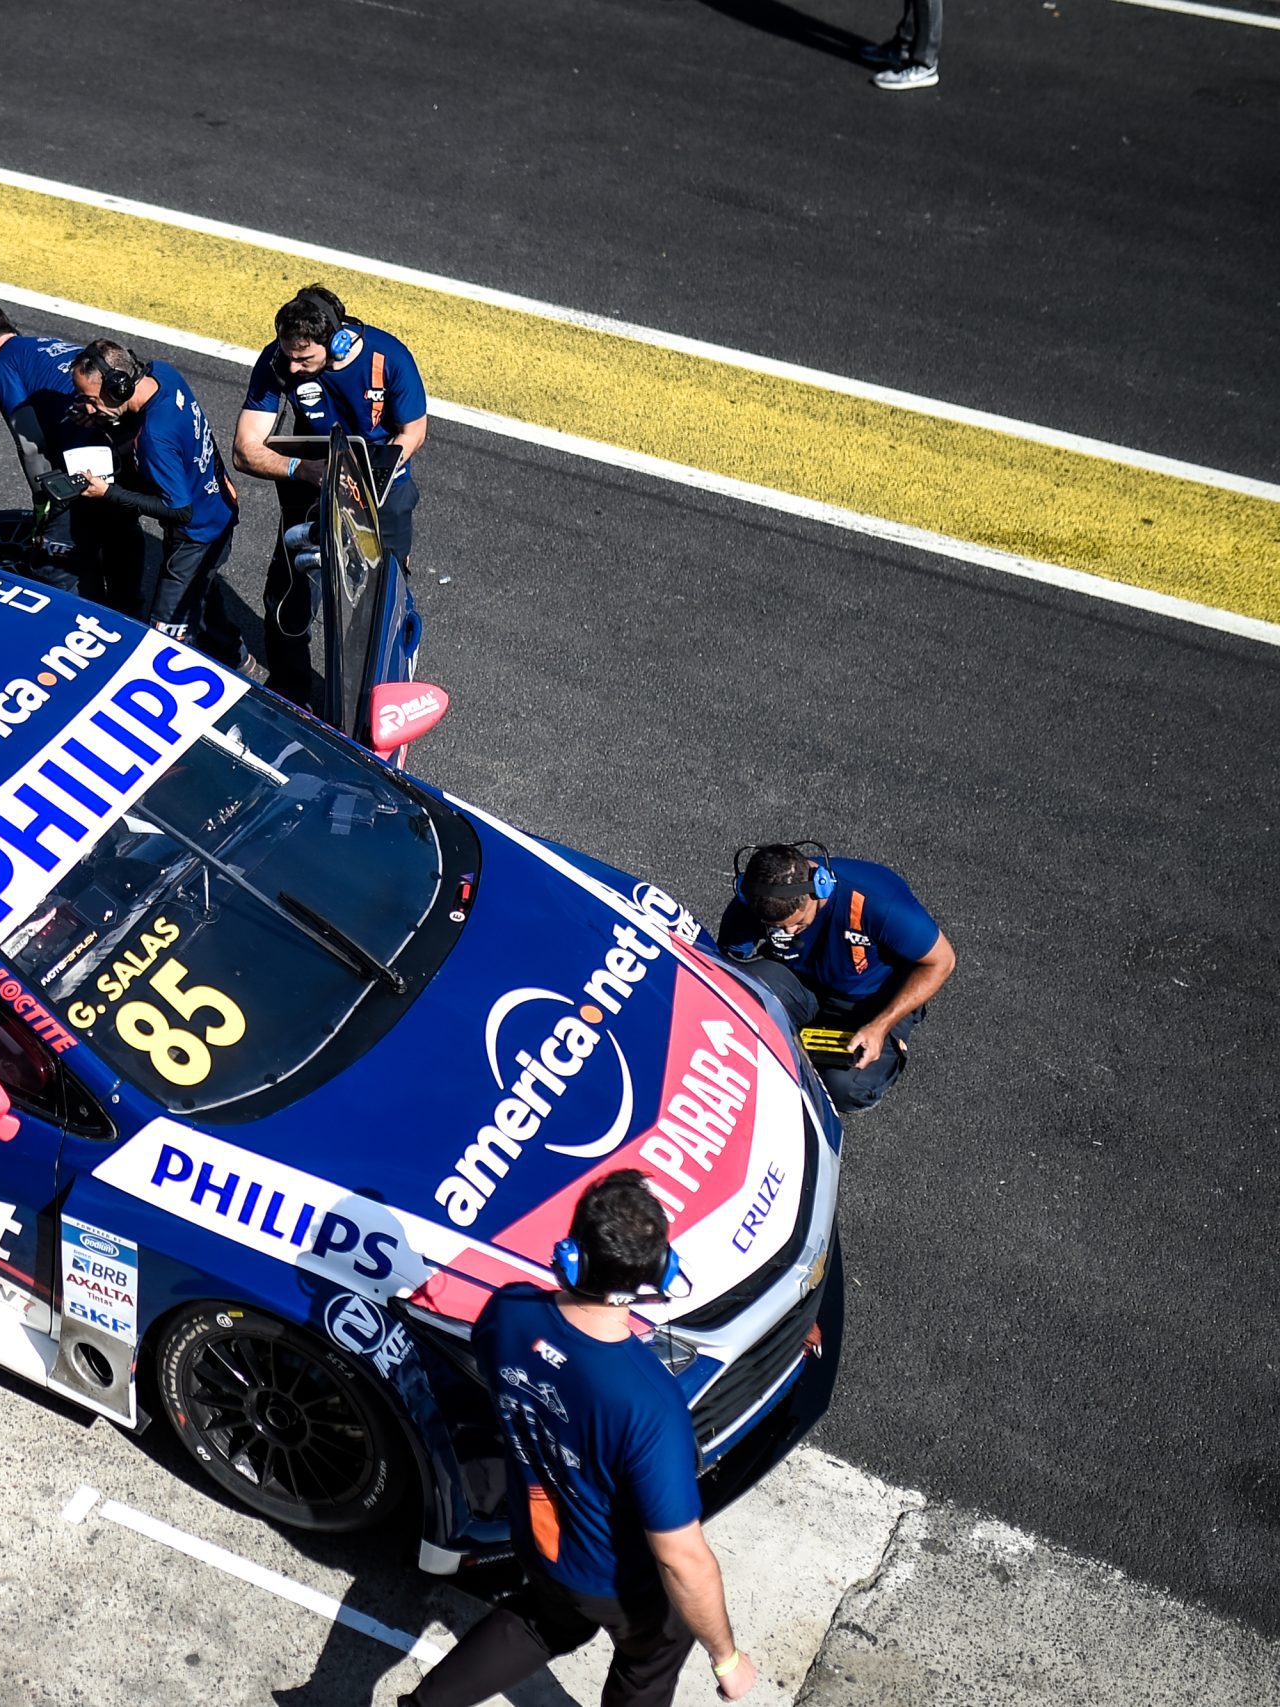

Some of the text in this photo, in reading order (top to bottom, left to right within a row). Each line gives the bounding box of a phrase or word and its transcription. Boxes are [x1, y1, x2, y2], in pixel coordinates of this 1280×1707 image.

[157, 621, 188, 636] KTF
[67, 916, 180, 1029] G. SALAS
[115, 962, 247, 1087] 85
[638, 1048, 752, 1193] PARAR
[150, 1143, 399, 1280] PHILIPS
[731, 1161, 786, 1254] CRUZE
[76, 1222, 111, 1239] POWERED
[83, 1236, 115, 1256] podium
[66, 1273, 135, 1307] AXALTA
[91, 1261, 128, 1288] BRB
[87, 1291, 113, 1308] Tintas
[69, 1301, 132, 1333] SKF
[373, 1321, 408, 1380] KTF
